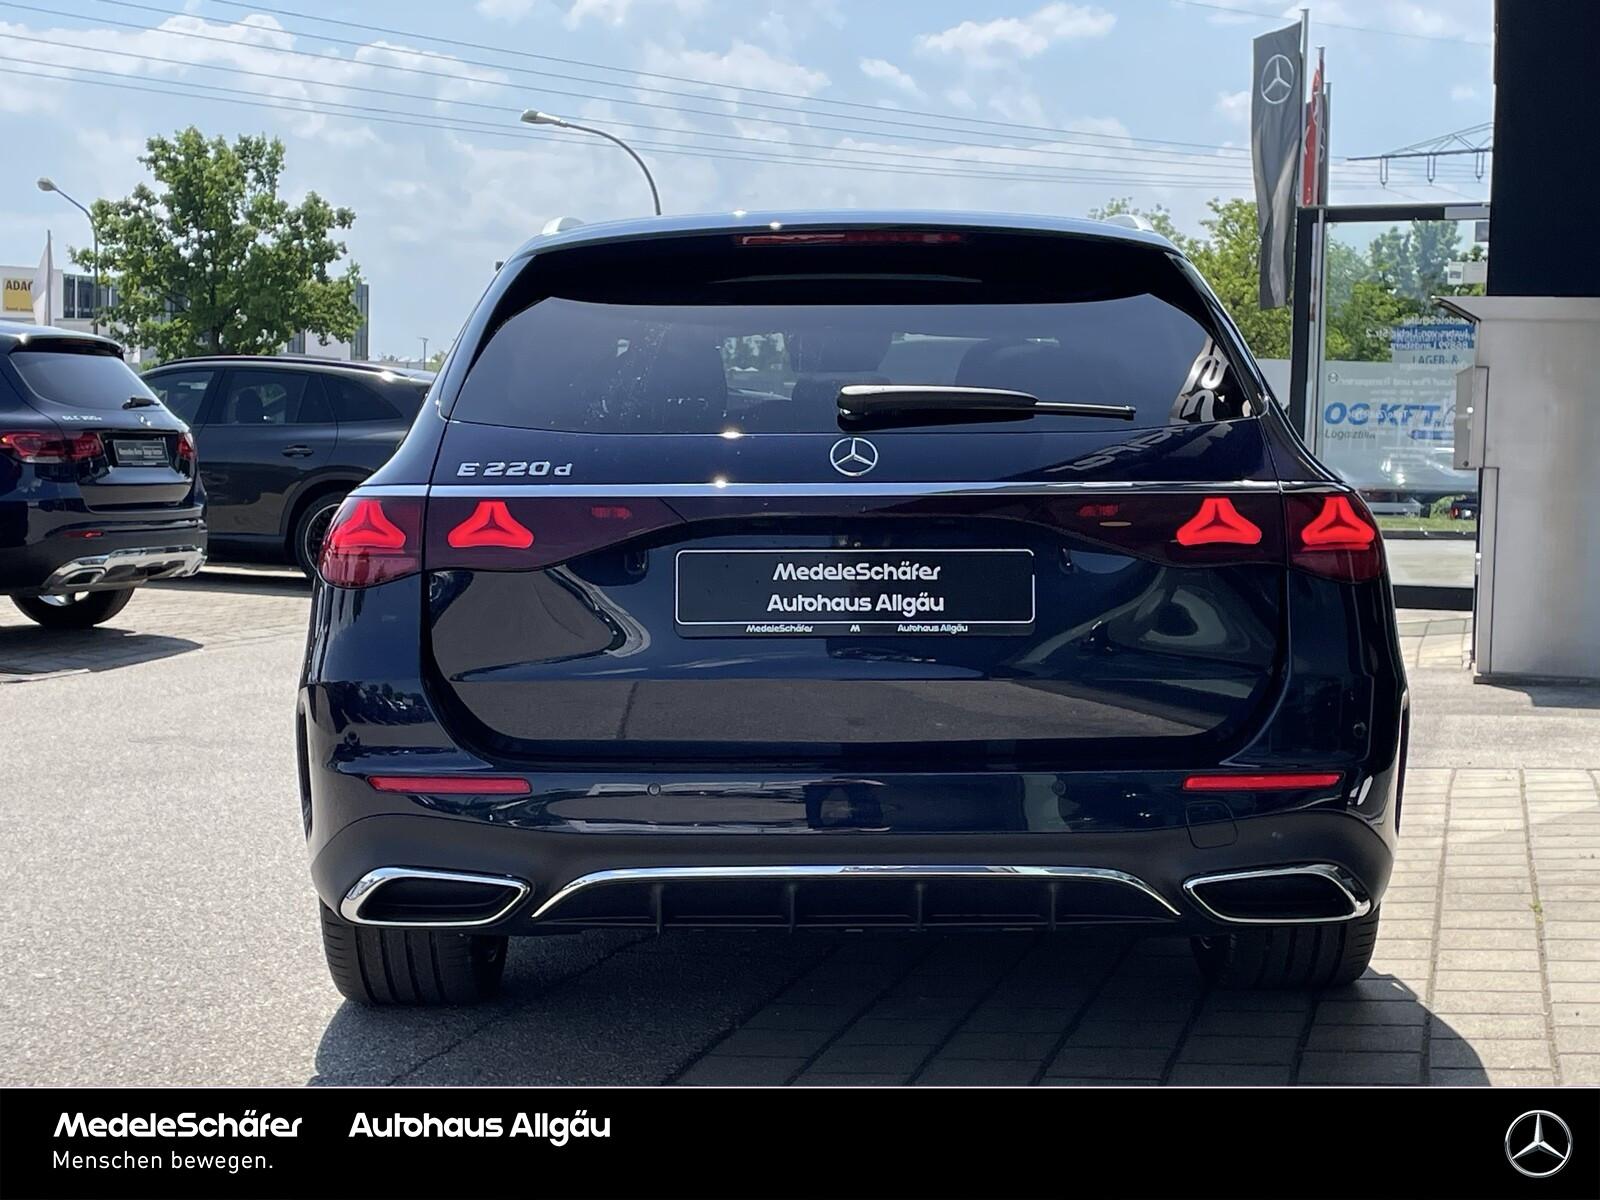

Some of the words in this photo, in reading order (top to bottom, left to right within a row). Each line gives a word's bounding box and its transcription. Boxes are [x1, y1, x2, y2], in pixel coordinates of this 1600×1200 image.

[772, 561, 941, 581] MedeleSchäfer
[766, 594, 872, 612] Autohaus
[875, 592, 945, 618] Allgäu
[746, 624, 813, 633] MedeleSchäfer
[897, 624, 939, 633] Autohaus
[940, 624, 968, 634] Allgäu
